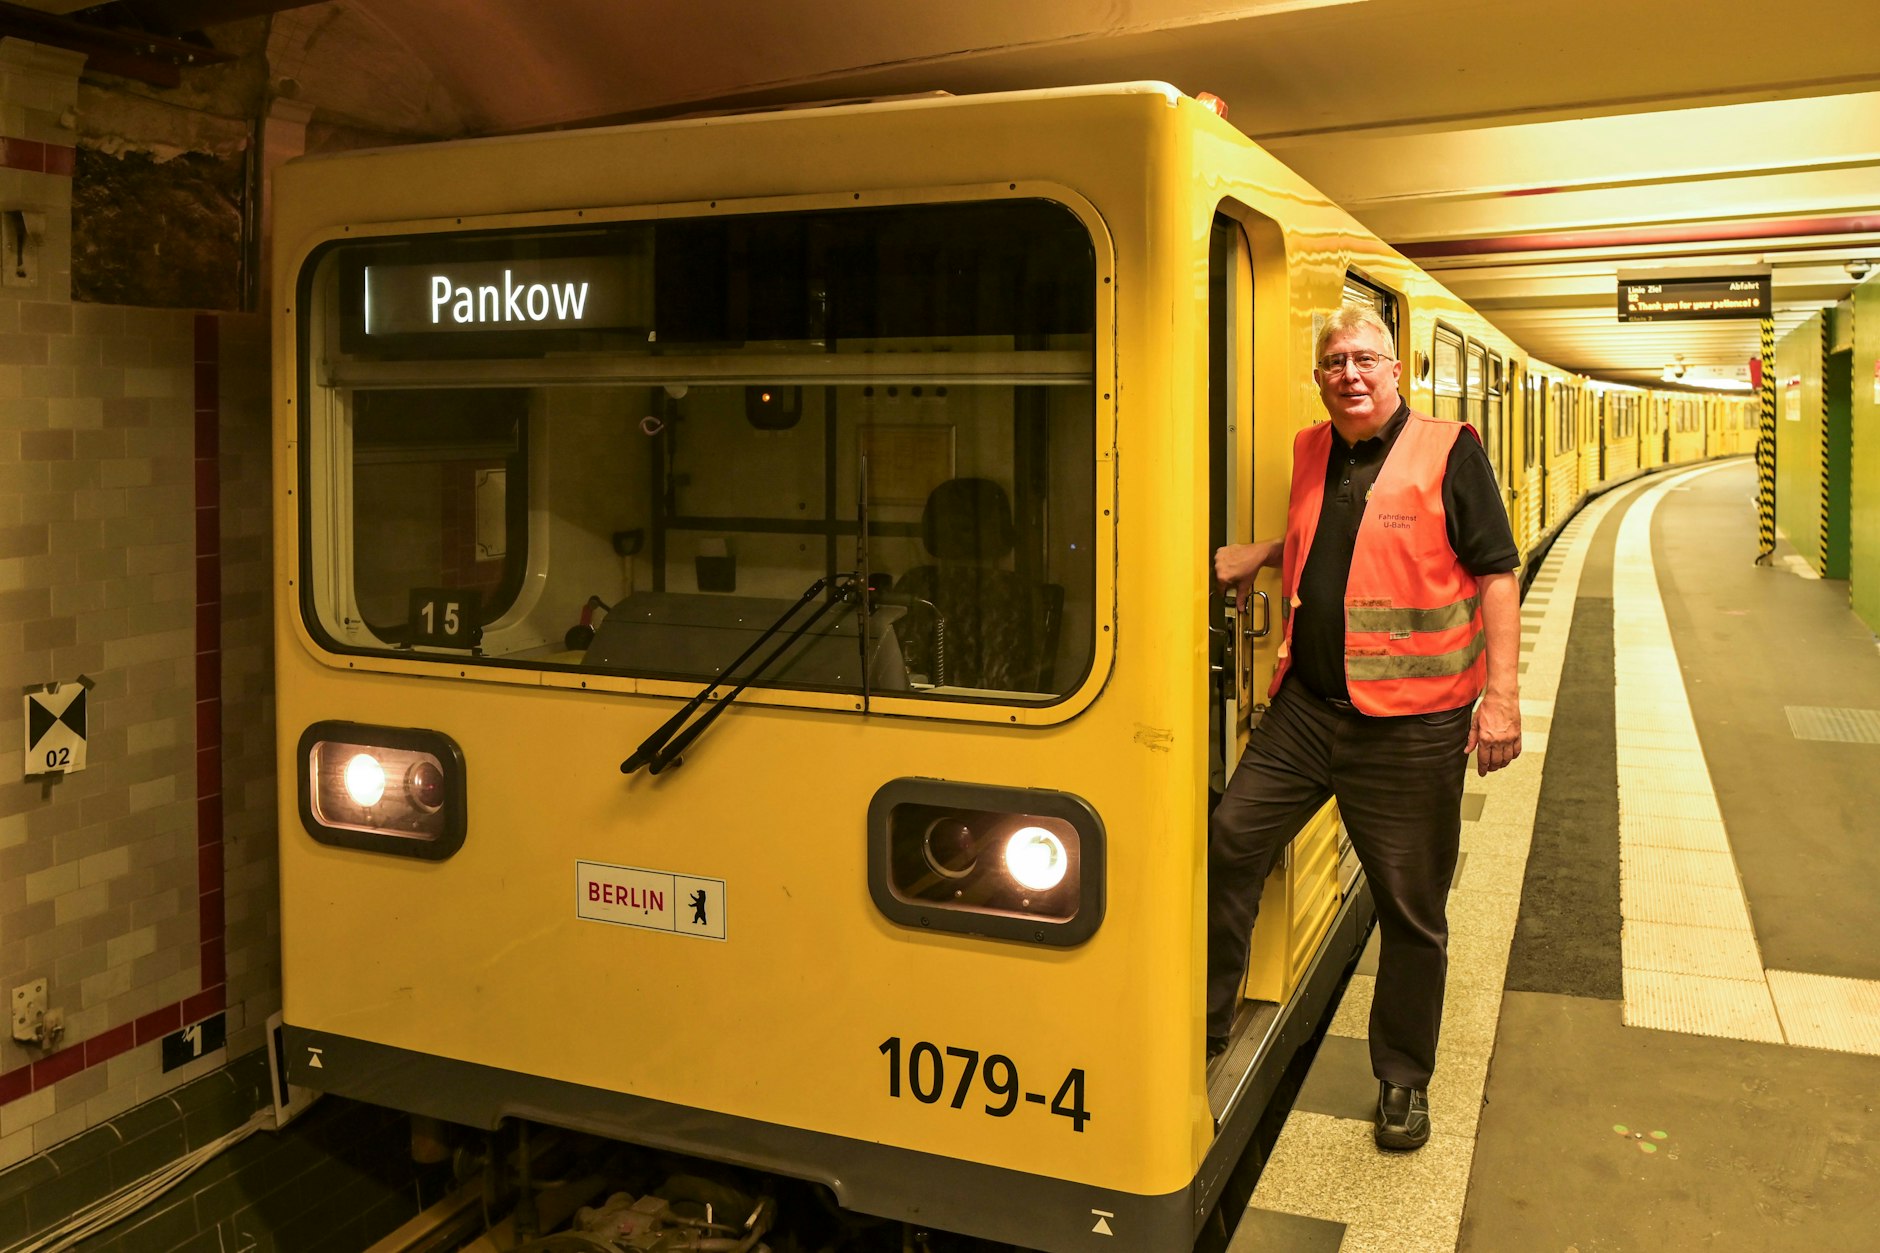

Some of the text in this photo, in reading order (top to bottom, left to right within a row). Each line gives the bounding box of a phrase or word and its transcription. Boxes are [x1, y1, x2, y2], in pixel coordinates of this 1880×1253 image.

[1628, 284, 1662, 294] Linie Ziel
[1729, 282, 1760, 291] Abfahrt
[431, 269, 589, 324] Pankow
[1637, 301, 1662, 311] Thank
[1662, 302, 1678, 311] you
[1679, 300, 1692, 310] for
[1693, 301, 1712, 310] your
[1713, 298, 1752, 310] patience!
[1378, 513, 1417, 521] Fahrdienst
[1383, 521, 1411, 529] U-Bahn
[46, 747, 70, 768] 02
[588, 881, 664, 912] BERLIN
[878, 1036, 1091, 1133] 1079-4
